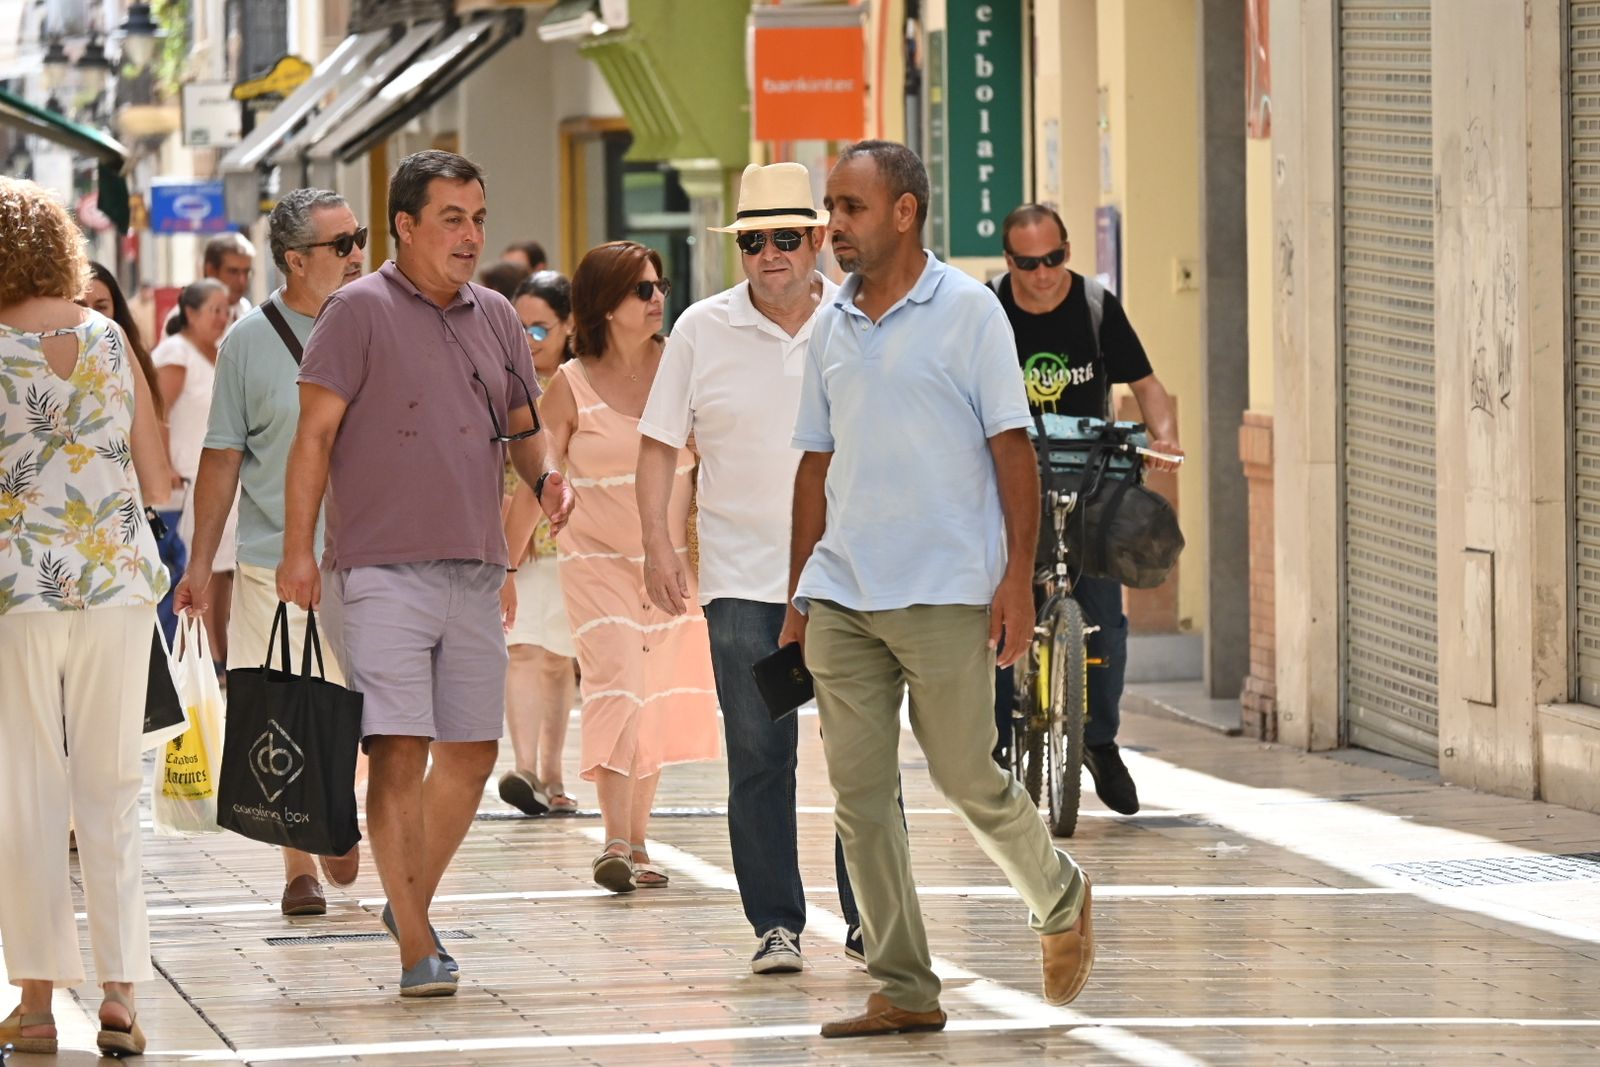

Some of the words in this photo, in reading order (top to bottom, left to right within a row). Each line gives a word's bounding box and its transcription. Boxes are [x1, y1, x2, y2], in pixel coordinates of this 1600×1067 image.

[975, 4, 996, 238] erbolario
[232, 802, 282, 820] carolina
[284, 806, 310, 823] box
